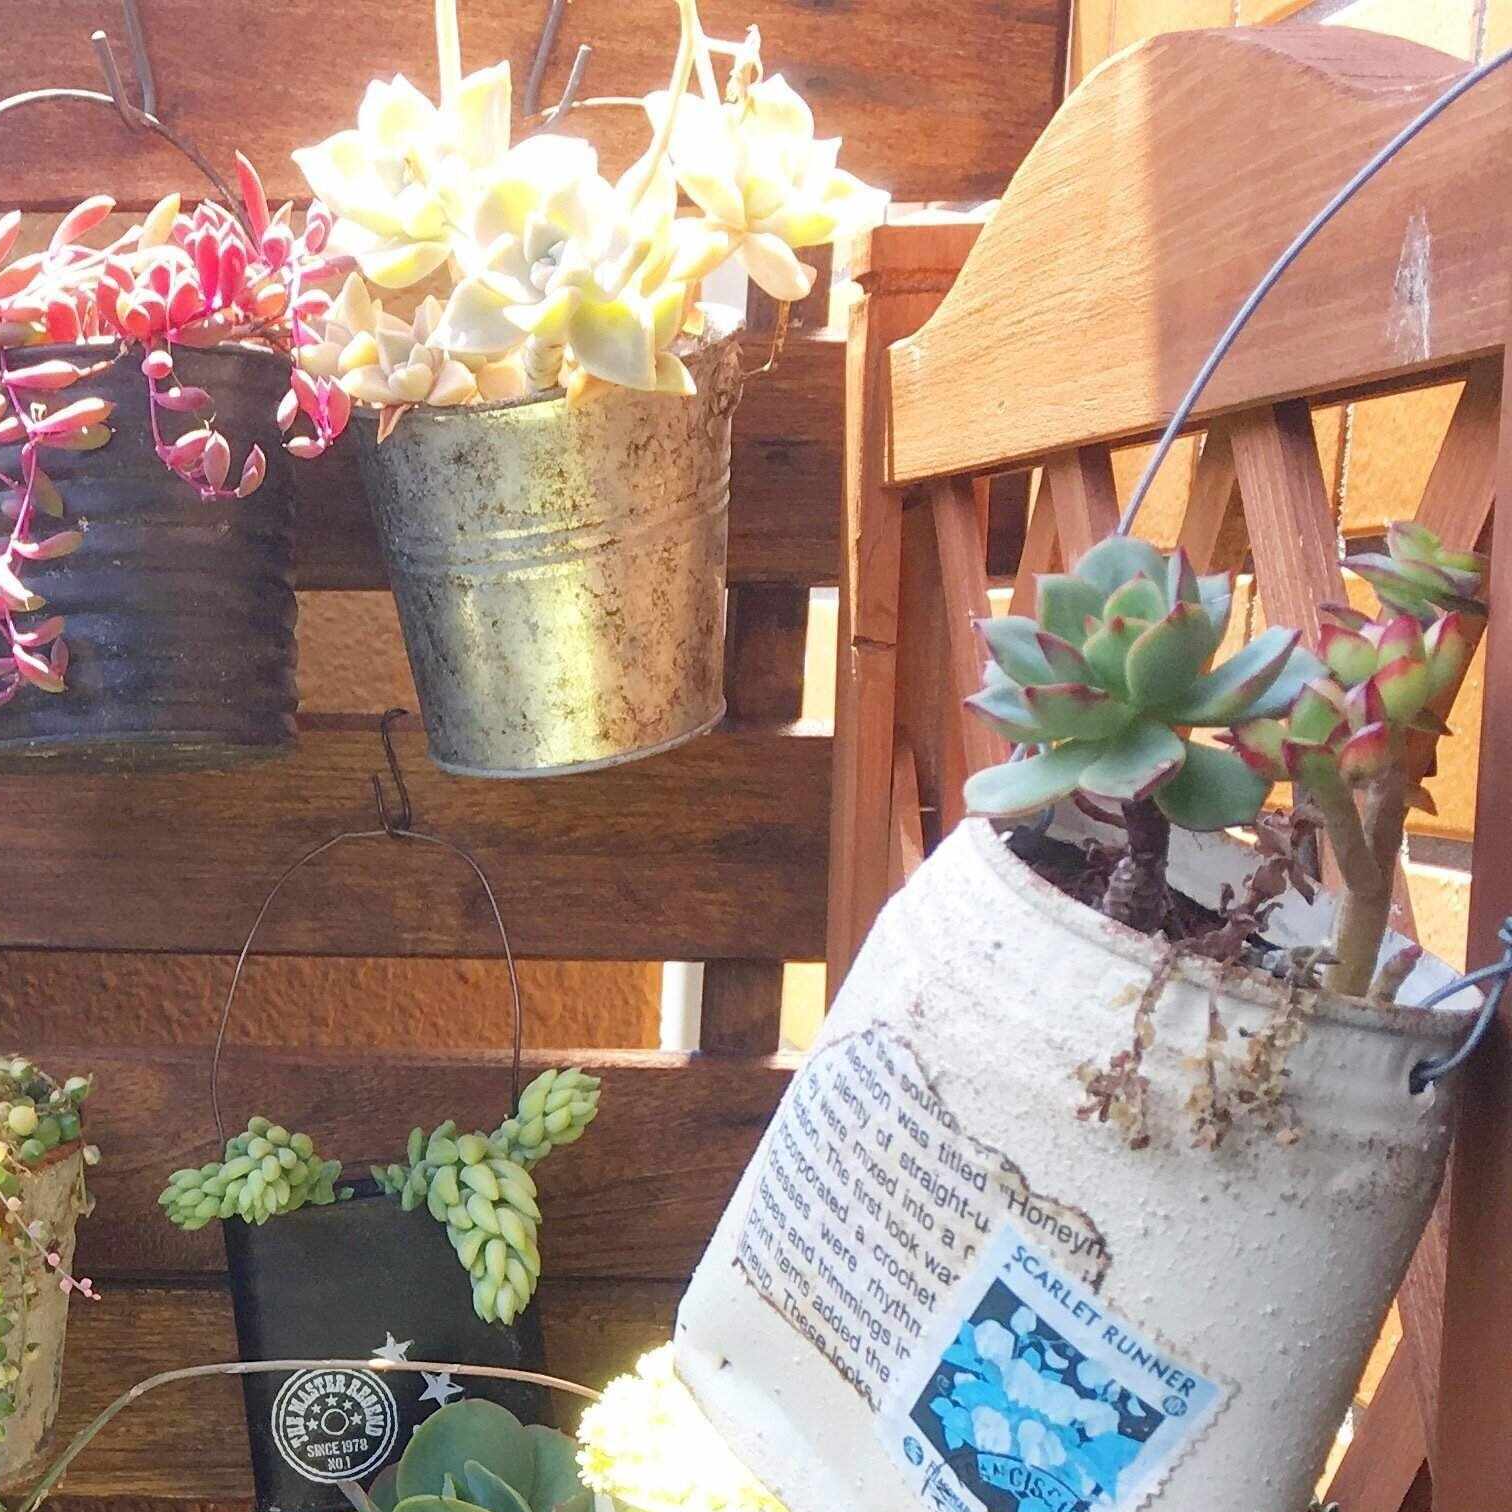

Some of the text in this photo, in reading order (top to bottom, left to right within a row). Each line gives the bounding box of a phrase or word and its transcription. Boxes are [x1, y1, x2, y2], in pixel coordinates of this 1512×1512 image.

[819, 1095, 849, 1143] were
[853, 1140, 899, 1198] mixed
[901, 1188, 935, 1231] into
[940, 1227, 956, 1249] a
[875, 1128, 894, 1151] of
[898, 1150, 991, 1234] straight-u
[896, 1107, 930, 1149] was
[938, 1141, 988, 1193] titled
[825, 1141, 851, 1187] The
[852, 1177, 884, 1222] first
[884, 1210, 921, 1258] look
[787, 1225, 816, 1265] and
[817, 1256, 892, 1347] trimmings
[820, 1221, 858, 1273] were
[854, 1224, 866, 1244] a
[872, 1243, 938, 1313] crochet
[773, 1241, 812, 1299] items
[811, 1294, 862, 1354] added
[864, 1345, 890, 1384] the
[781, 1286, 828, 1352] These
[1010, 1244, 1197, 1399] SCARLET RUNNER
[286, 1416, 310, 1449] THE
[287, 1374, 346, 1416] MASTER
[306, 1438, 369, 1458] SINCE 1978
